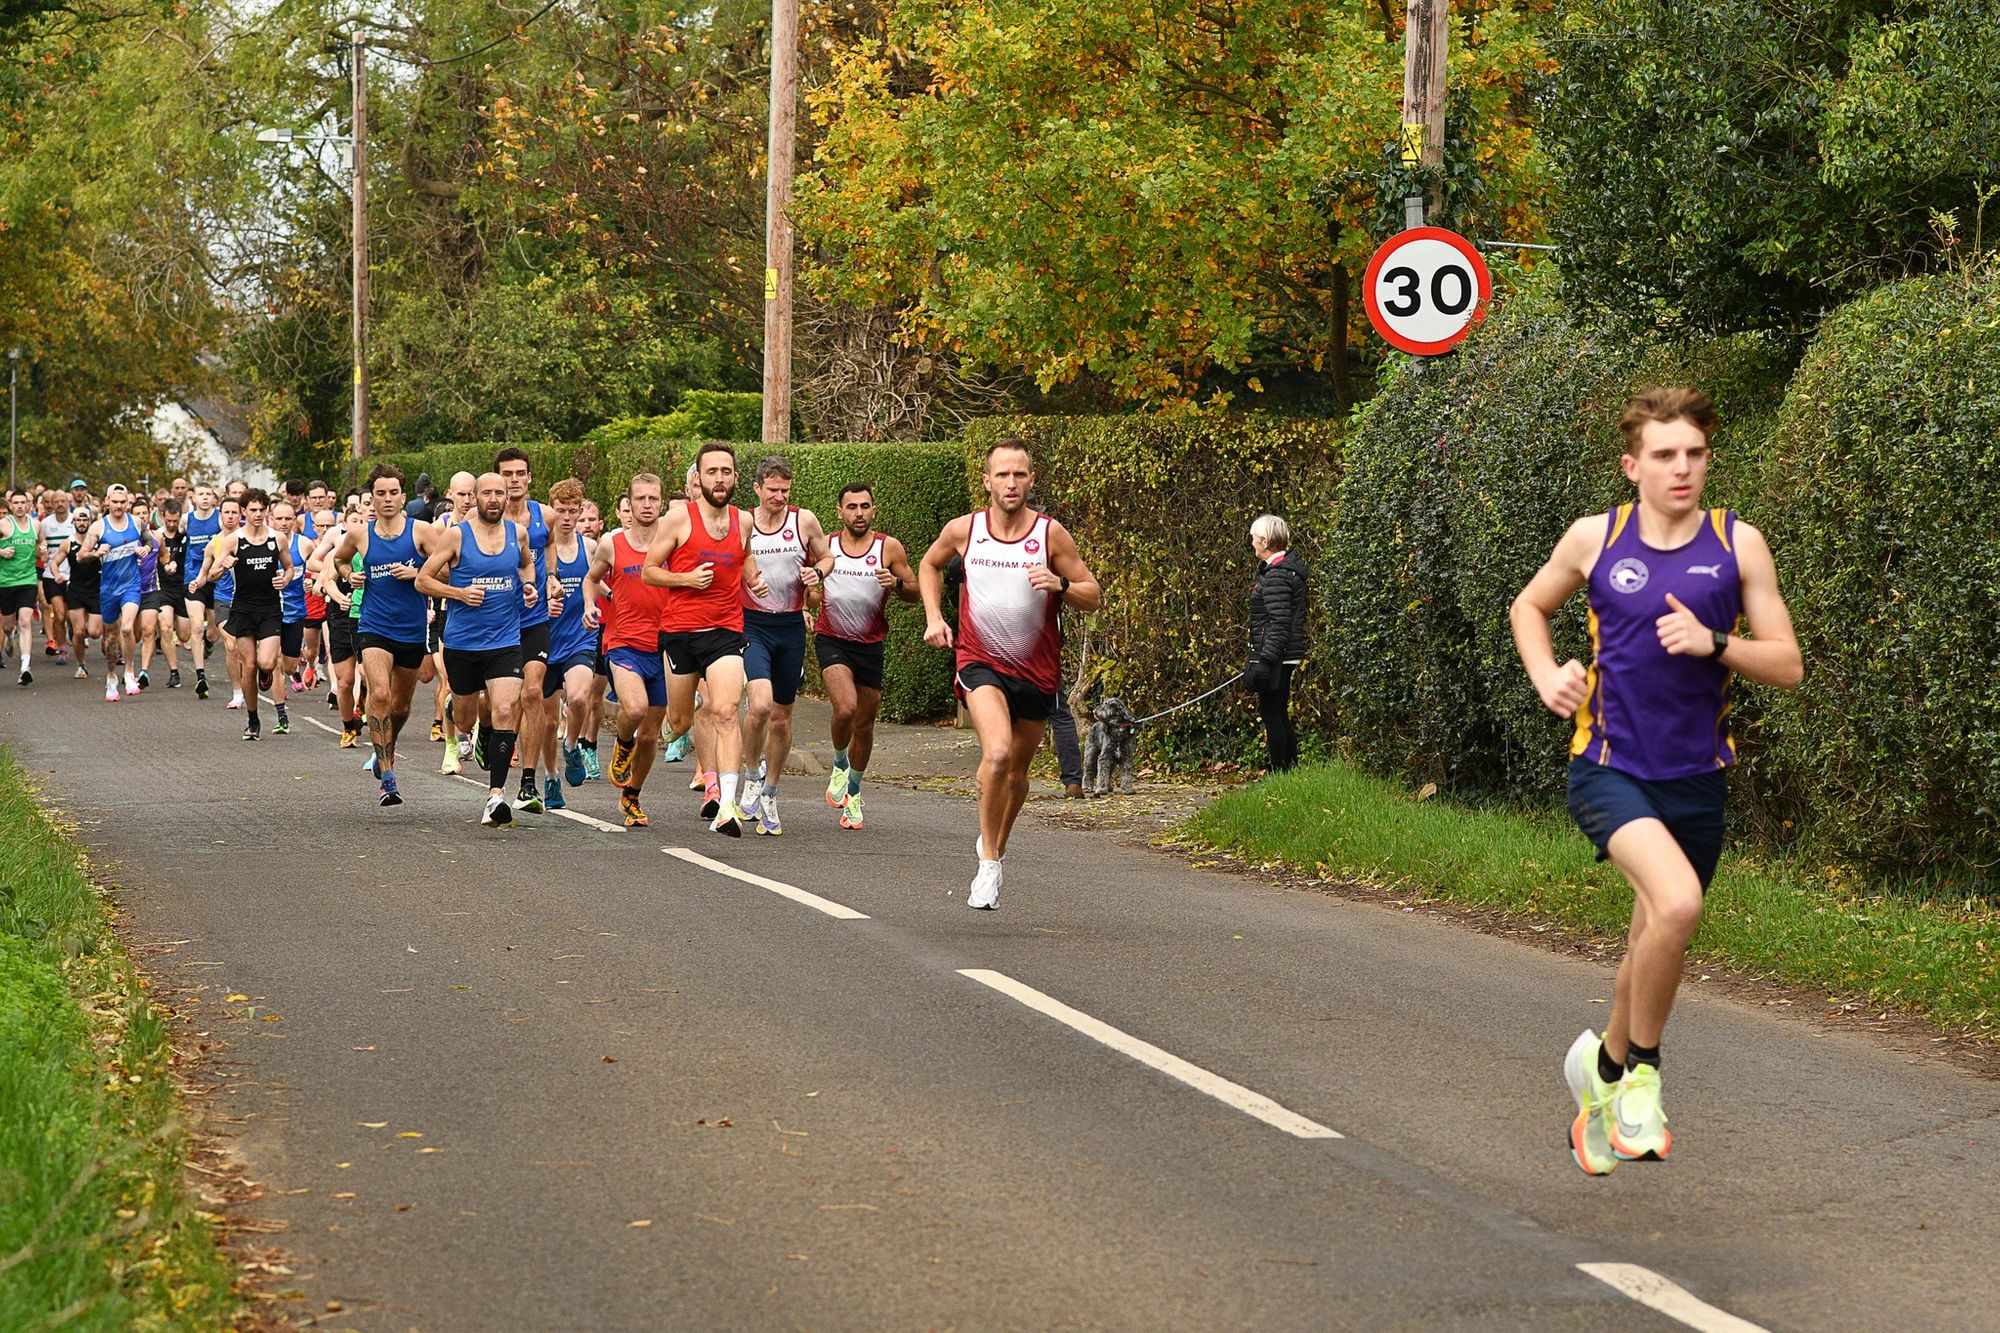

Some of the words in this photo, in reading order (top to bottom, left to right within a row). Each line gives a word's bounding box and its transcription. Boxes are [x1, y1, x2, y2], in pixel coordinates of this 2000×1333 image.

[1383, 264, 1472, 317] 30
[246, 556, 273, 565] DEESIDE
[970, 558, 1019, 569] WREXHAM
[254, 563, 267, 571] AAC
[832, 568, 863, 577] REXHAM
[472, 576, 504, 584] BUCKLEY
